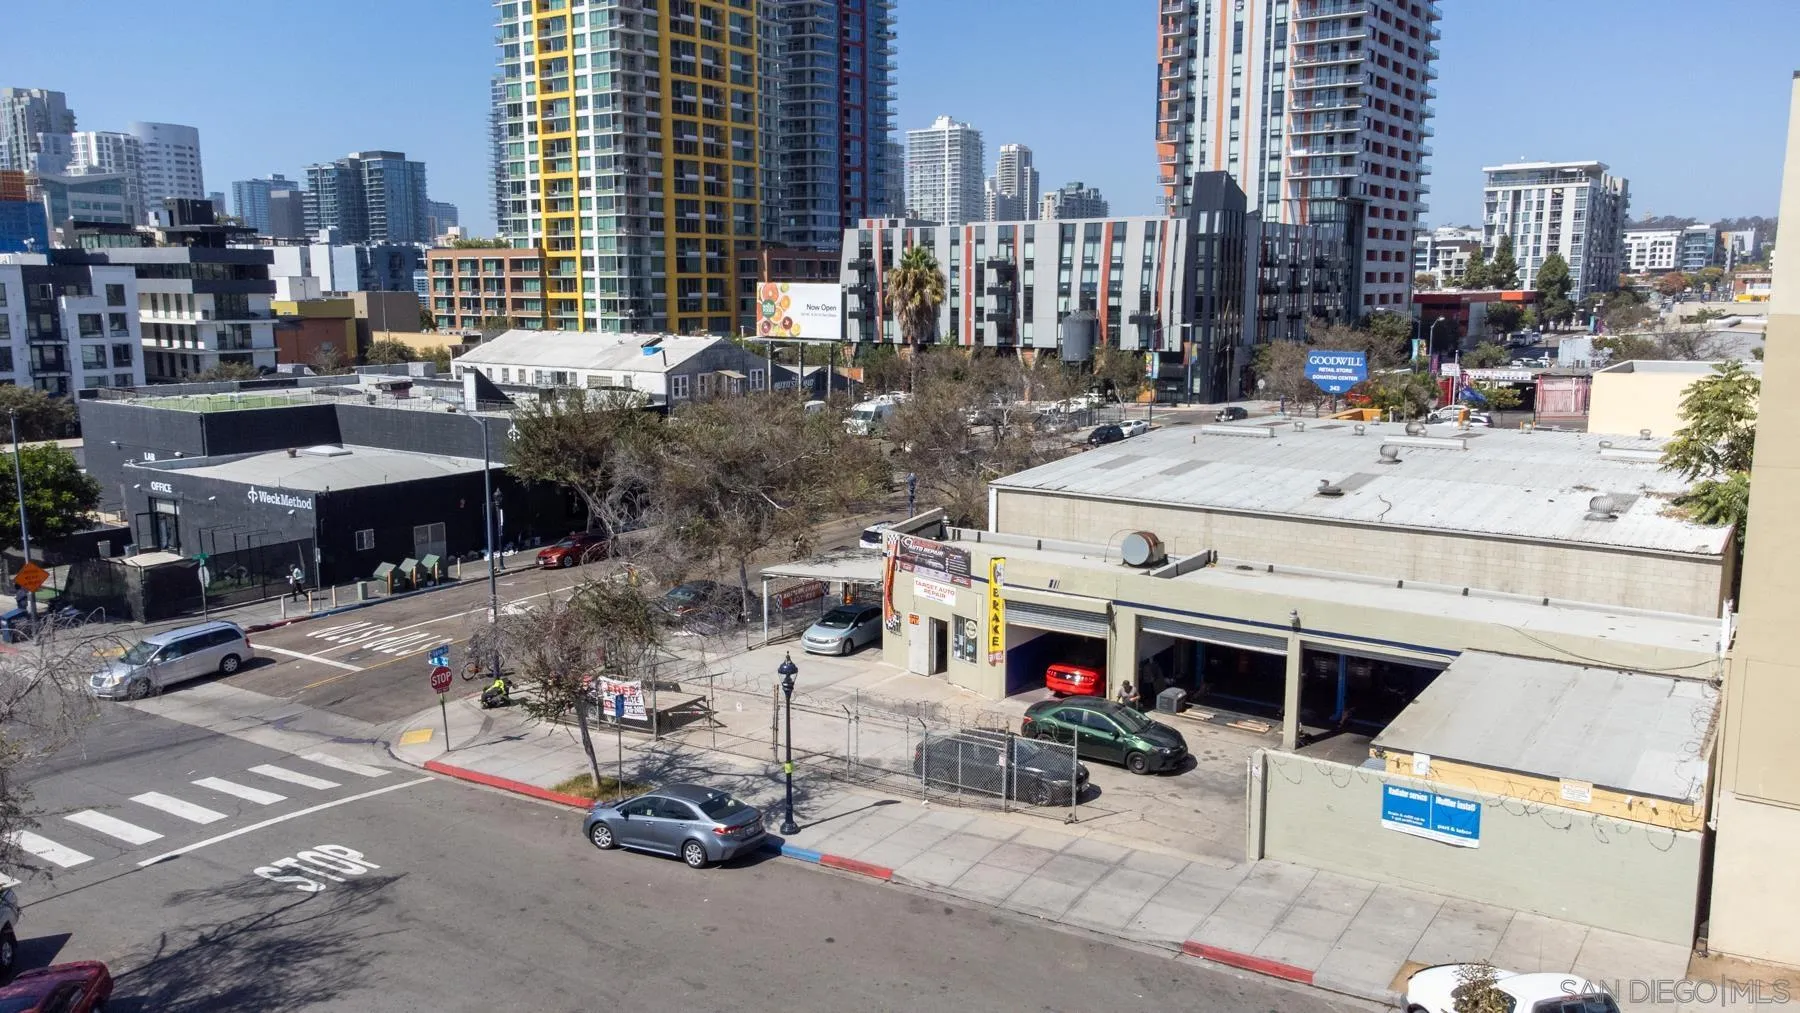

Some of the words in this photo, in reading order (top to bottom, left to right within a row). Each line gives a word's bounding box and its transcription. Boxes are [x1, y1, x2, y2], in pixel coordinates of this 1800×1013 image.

[821, 303, 836, 312] Open
[1309, 356, 1363, 366] GOODWILL
[144, 452, 155, 461] LAB
[151, 481, 172, 493] OFFICE
[258, 490, 312, 510] WeckMethod
[915, 580, 937, 590] TARGET
[938, 586, 955, 596] AUTO
[924, 588, 946, 598] REPAIR
[432, 671, 451, 686] STOP
[253, 844, 381, 891] STOP
